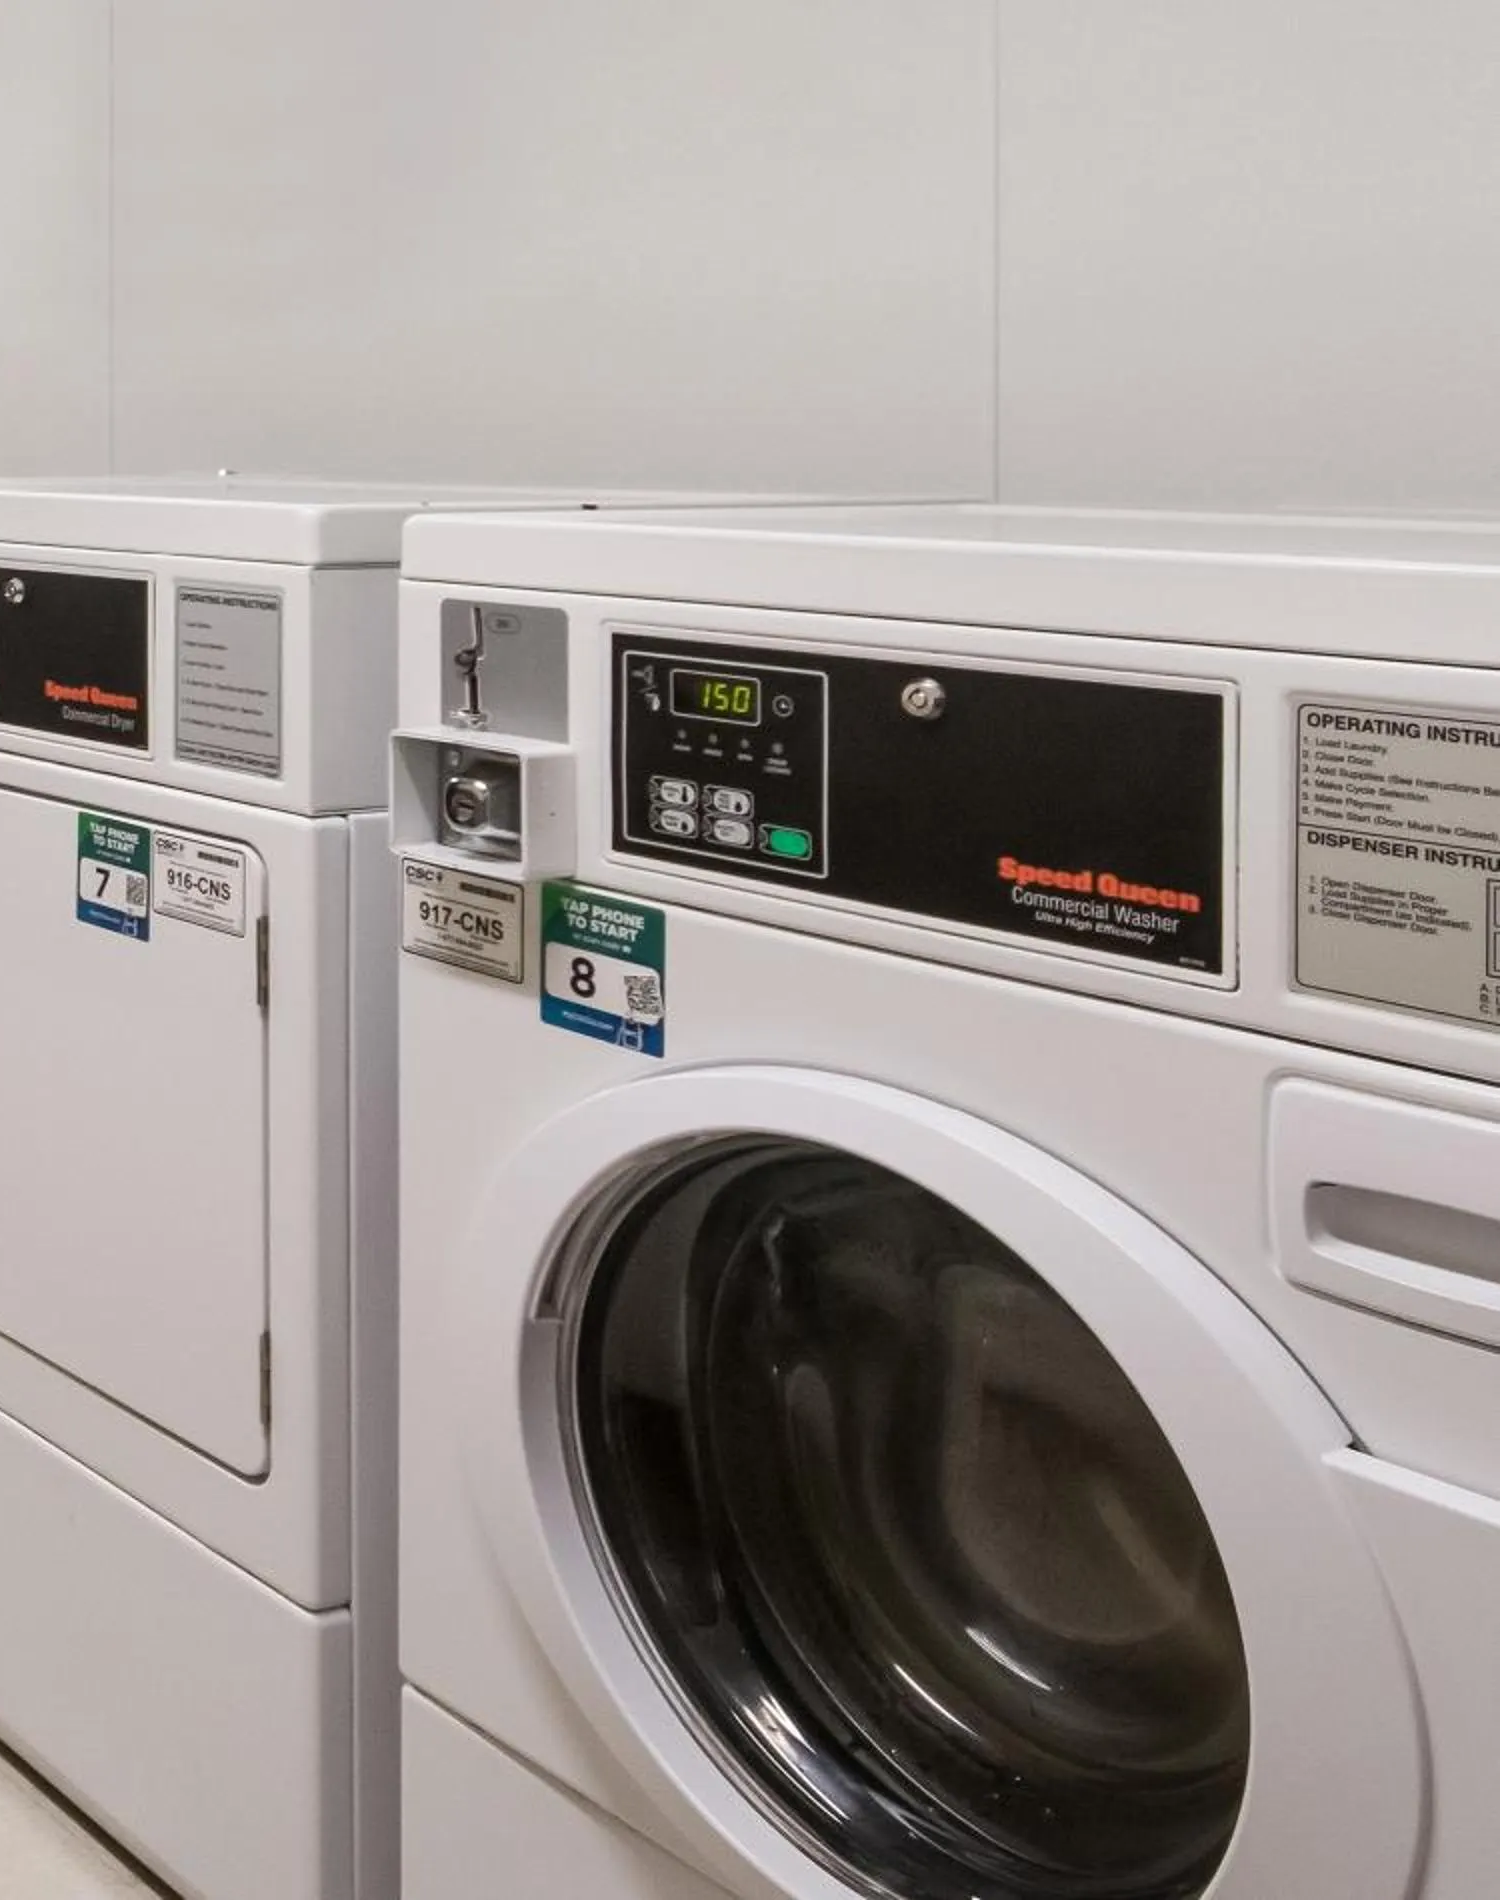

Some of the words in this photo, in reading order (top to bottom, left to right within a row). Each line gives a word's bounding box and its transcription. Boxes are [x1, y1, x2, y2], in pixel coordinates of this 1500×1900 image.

[44, 680, 89, 702] Speed
[90, 686, 137, 710] Queen
[702, 682, 750, 713] 150
[1307, 712, 1421, 738] OPERATING
[1315, 738, 1341, 748] Load
[1307, 831, 1419, 860] DISPENSER
[1424, 847, 1500, 872] INSTRU
[95, 868, 111, 897] 7
[167, 868, 231, 900] 916-CNS
[998, 856, 1093, 893] Speed
[1097, 873, 1201, 912] Queen
[419, 901, 504, 940] 917-CNS
[562, 898, 589, 913] TAP
[591, 905, 645, 930] PHONE
[1011, 886, 1109, 919] Commercial
[1114, 905, 1180, 933] Washer
[567, 914, 587, 929] TO
[590, 919, 639, 942] START
[1035, 911, 1063, 926] Ultra
[1065, 917, 1093, 931] High
[1095, 922, 1155, 944] Efficiency
[569, 957, 596, 998] 8
